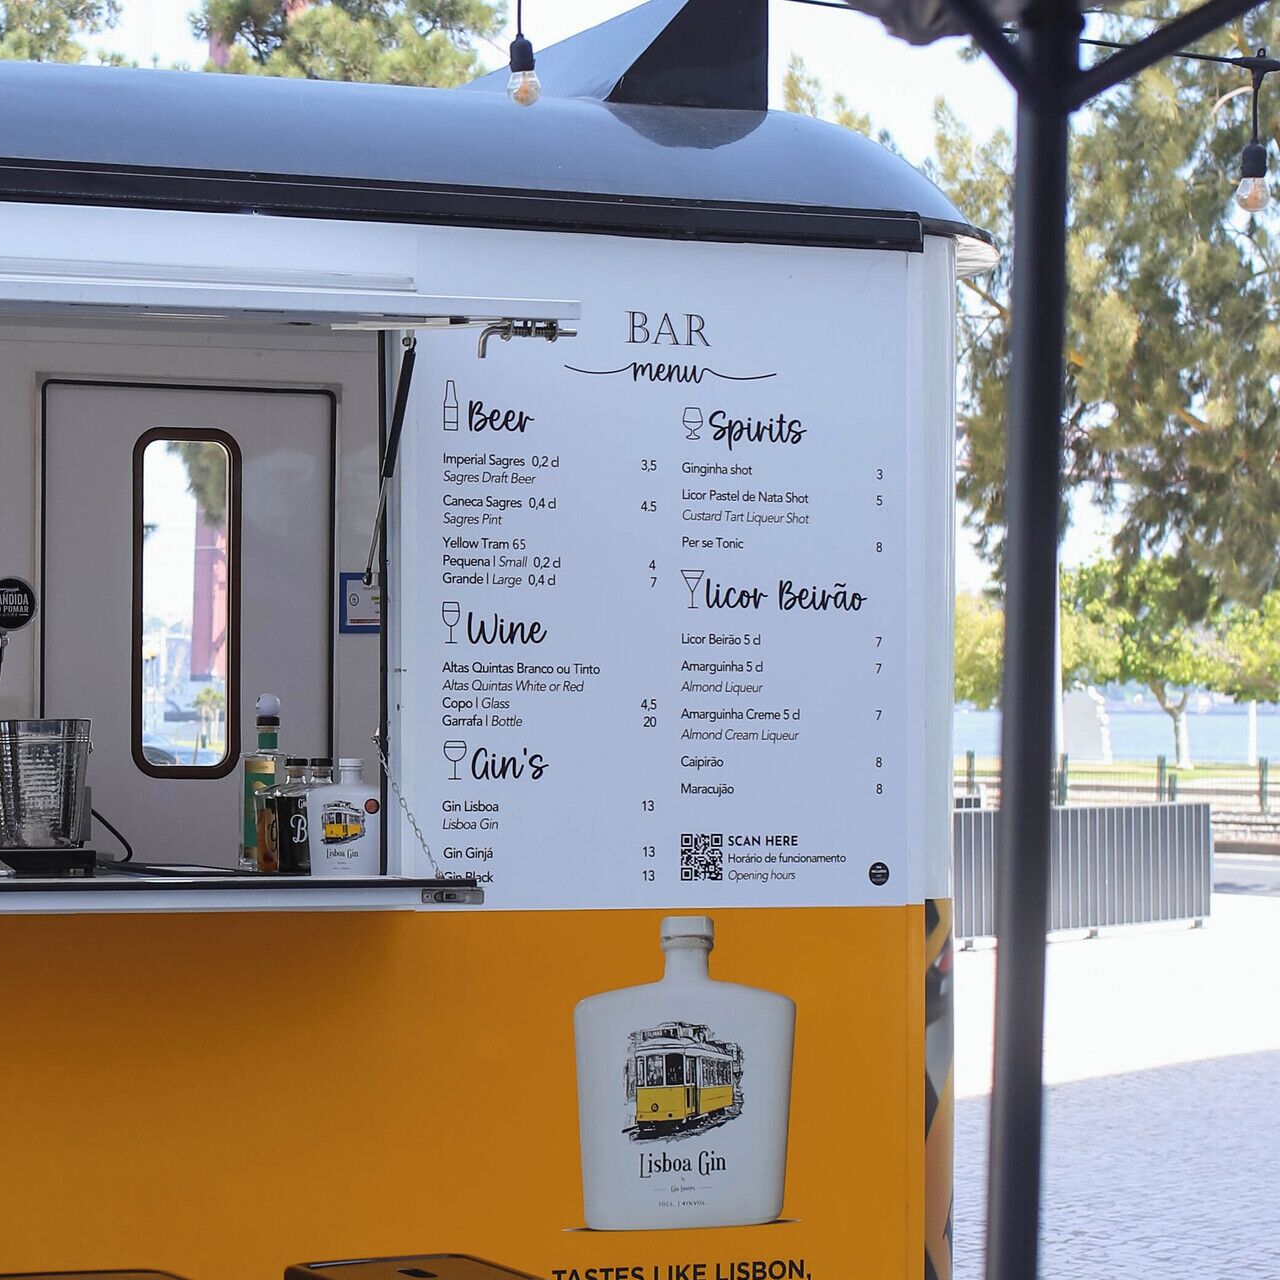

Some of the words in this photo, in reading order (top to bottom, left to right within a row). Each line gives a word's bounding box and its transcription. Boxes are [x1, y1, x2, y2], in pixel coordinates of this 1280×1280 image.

[626, 311, 711, 347] BAR
[631, 362, 701, 383] menu
[469, 400, 534, 433] Beer
[709, 410, 807, 451] Spirits
[444, 453, 486, 468] Imperial
[489, 454, 525, 469] Sagres
[532, 456, 548, 469] 0,2
[551, 456, 559, 467] d
[641, 459, 657, 472] 3,5
[682, 462, 727, 477] Ginginha
[730, 464, 752, 475] shot
[877, 469, 883, 480] 3
[443, 469, 479, 485] Sagres
[482, 471, 509, 483] Draft
[511, 473, 536, 484] Beer
[443, 495, 483, 507] Caneca
[486, 496, 522, 510] Sagres
[529, 497, 545, 510] 0,4
[548, 498, 556, 509] d
[682, 489, 707, 500] Licor
[710, 490, 739, 501] Pastel
[742, 490, 755, 502] de
[759, 491, 783, 502] Nata
[786, 492, 809, 503] Shot
[876, 495, 882, 506] 5
[641, 501, 657, 512] 4.5
[443, 512, 479, 527] Sagres
[482, 513, 502, 525] Pint
[682, 509, 722, 521] Custard
[725, 511, 744, 522] Tart
[747, 512, 785, 526] Liqueur
[786, 512, 809, 524] Shot
[442, 537, 479, 548] Yellow
[481, 538, 509, 549] Tram
[513, 539, 526, 550] 65
[682, 536, 699, 547] Per
[702, 540, 713, 548] se
[715, 537, 744, 549] Tonic
[876, 542, 882, 552] 8
[443, 555, 490, 569] Pequena
[499, 556, 527, 567] Small
[533, 557, 550, 569] 0,2
[553, 557, 560, 568] d
[649, 560, 656, 570] 4
[443, 572, 483, 584] Grande
[492, 574, 522, 588] Large
[528, 574, 545, 587] 0,4
[547, 574, 555, 585] d
[651, 577, 657, 587] 7
[779, 580, 867, 611] Beirão
[468, 612, 547, 644] Wine
[682, 633, 706, 644] Licor
[709, 634, 741, 645] Beirão
[744, 634, 750, 645] 5
[753, 634, 761, 645] d
[876, 637, 882, 647] 7
[442, 661, 469, 673] Altas
[472, 662, 514, 673] Quintas
[517, 662, 554, 674] Branco
[557, 666, 570, 674] ou
[573, 663, 600, 674] Tinto
[681, 661, 743, 675] Amarguinha
[746, 661, 752, 672] 5
[755, 661, 763, 672] d
[876, 663, 882, 674] 7
[442, 679, 469, 691] Altas
[472, 679, 513, 692] Quintas
[516, 680, 546, 691] White
[563, 680, 584, 692] Red
[681, 681, 723, 692] Almond
[725, 682, 763, 696] Liqueur
[442, 697, 473, 712] Copo
[482, 697, 509, 709] Glass
[641, 699, 657, 711] 4,5
[442, 714, 482, 726] Garrafa
[492, 715, 522, 726] Bottle
[644, 716, 657, 727] 20
[681, 708, 743, 722] Amarguinha
[746, 709, 781, 720] Creme
[783, 709, 789, 720] 5
[792, 709, 800, 720] d
[876, 710, 882, 720] 7
[681, 728, 723, 741] Almond
[725, 729, 758, 740] Cream
[761, 729, 799, 744] Liqueur
[472, 748, 549, 780] Gin's
[681, 756, 724, 770] Caipirão
[876, 757, 882, 767] 8
[681, 783, 734, 797] Maracujão
[876, 784, 882, 794] 8
[442, 801, 461, 812] Gin
[465, 800, 499, 812] Lisboa
[642, 800, 654, 811] 13
[443, 818, 477, 830] Lisboa
[480, 818, 498, 830] Gin
[728, 836, 760, 846] SCAN
[766, 835, 798, 846] HERE
[347, 848, 359, 858] Gin
[444, 847, 462, 858] Gin
[643, 846, 655, 857] 13
[728, 853, 762, 863] Horário
[764, 852, 776, 863] de
[779, 852, 846, 863] funcionamento
[643, 870, 655, 881] 13
[728, 870, 769, 883] Opening
[771, 870, 796, 880] hours
[640, 1152, 692, 1178] Lisboa
[699, 1151, 726, 1176] Gin
